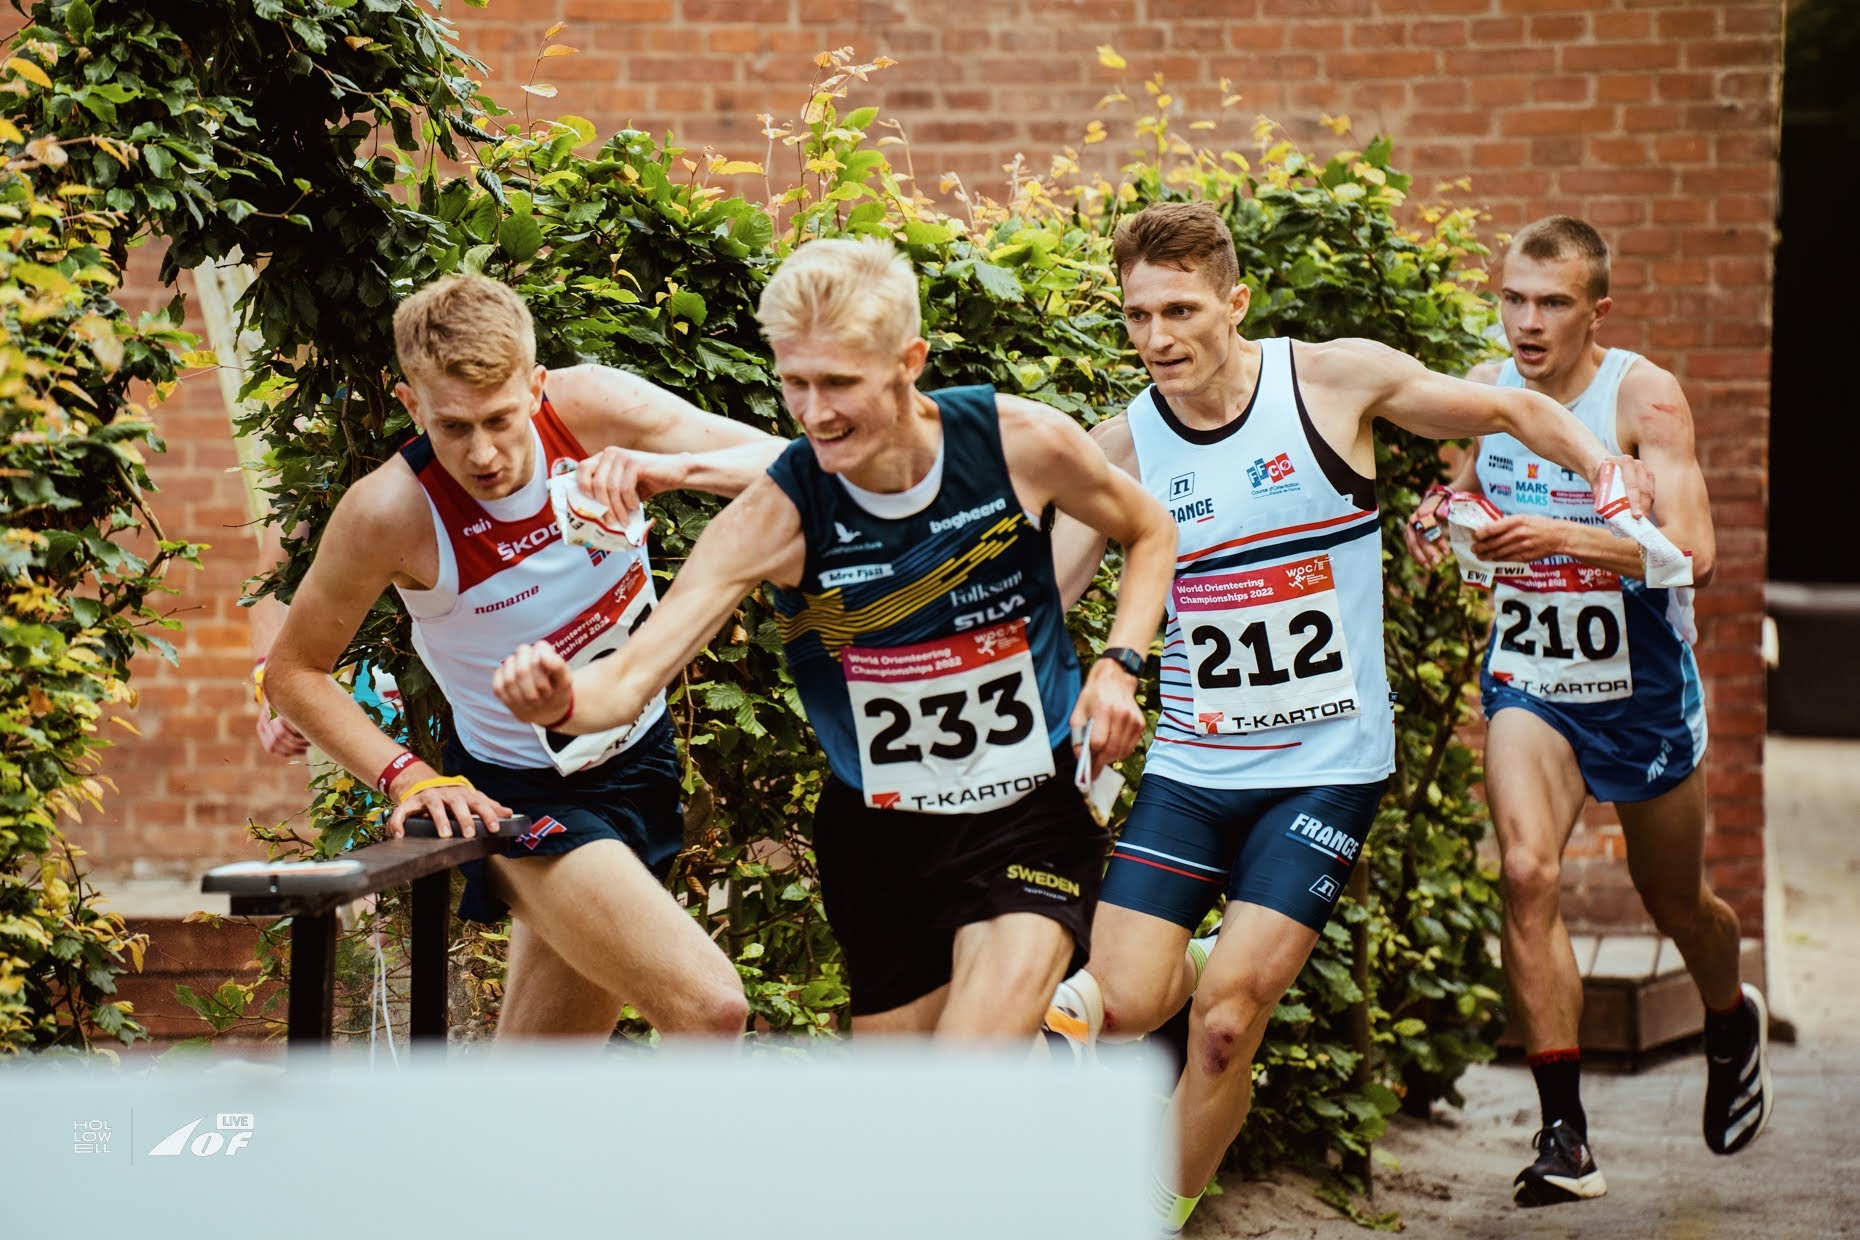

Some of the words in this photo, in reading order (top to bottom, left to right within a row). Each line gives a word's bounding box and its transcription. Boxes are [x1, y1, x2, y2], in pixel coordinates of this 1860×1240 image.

[1515, 481, 1549, 494] MARS
[1515, 493, 1548, 507] MARS
[928, 497, 1007, 534] bagheera
[1552, 515, 1606, 525] RMIN
[497, 522, 561, 561] ŠKOD
[474, 584, 540, 614] noname
[1176, 583, 1204, 594] World
[1204, 577, 1265, 592] Orienteering
[1179, 591, 1249, 605] Championships
[1249, 586, 1275, 599] 2022
[953, 593, 1027, 632] SILVA
[553, 611, 602, 649] rienteering
[1500, 599, 1620, 661] 210
[847, 652, 880, 666] World
[880, 647, 953, 666] Orienteering
[1191, 609, 1344, 690] 212
[850, 663, 935, 679] Championships
[934, 655, 963, 672] 2022
[1520, 679, 1629, 695] T-KARTOR
[864, 671, 1034, 766] 233
[1232, 698, 1356, 731] T-KARTOR
[912, 773, 1053, 811] T-KARTOR
[1289, 812, 1360, 862] FRANCE
[1006, 863, 1080, 898] SWEDEN
